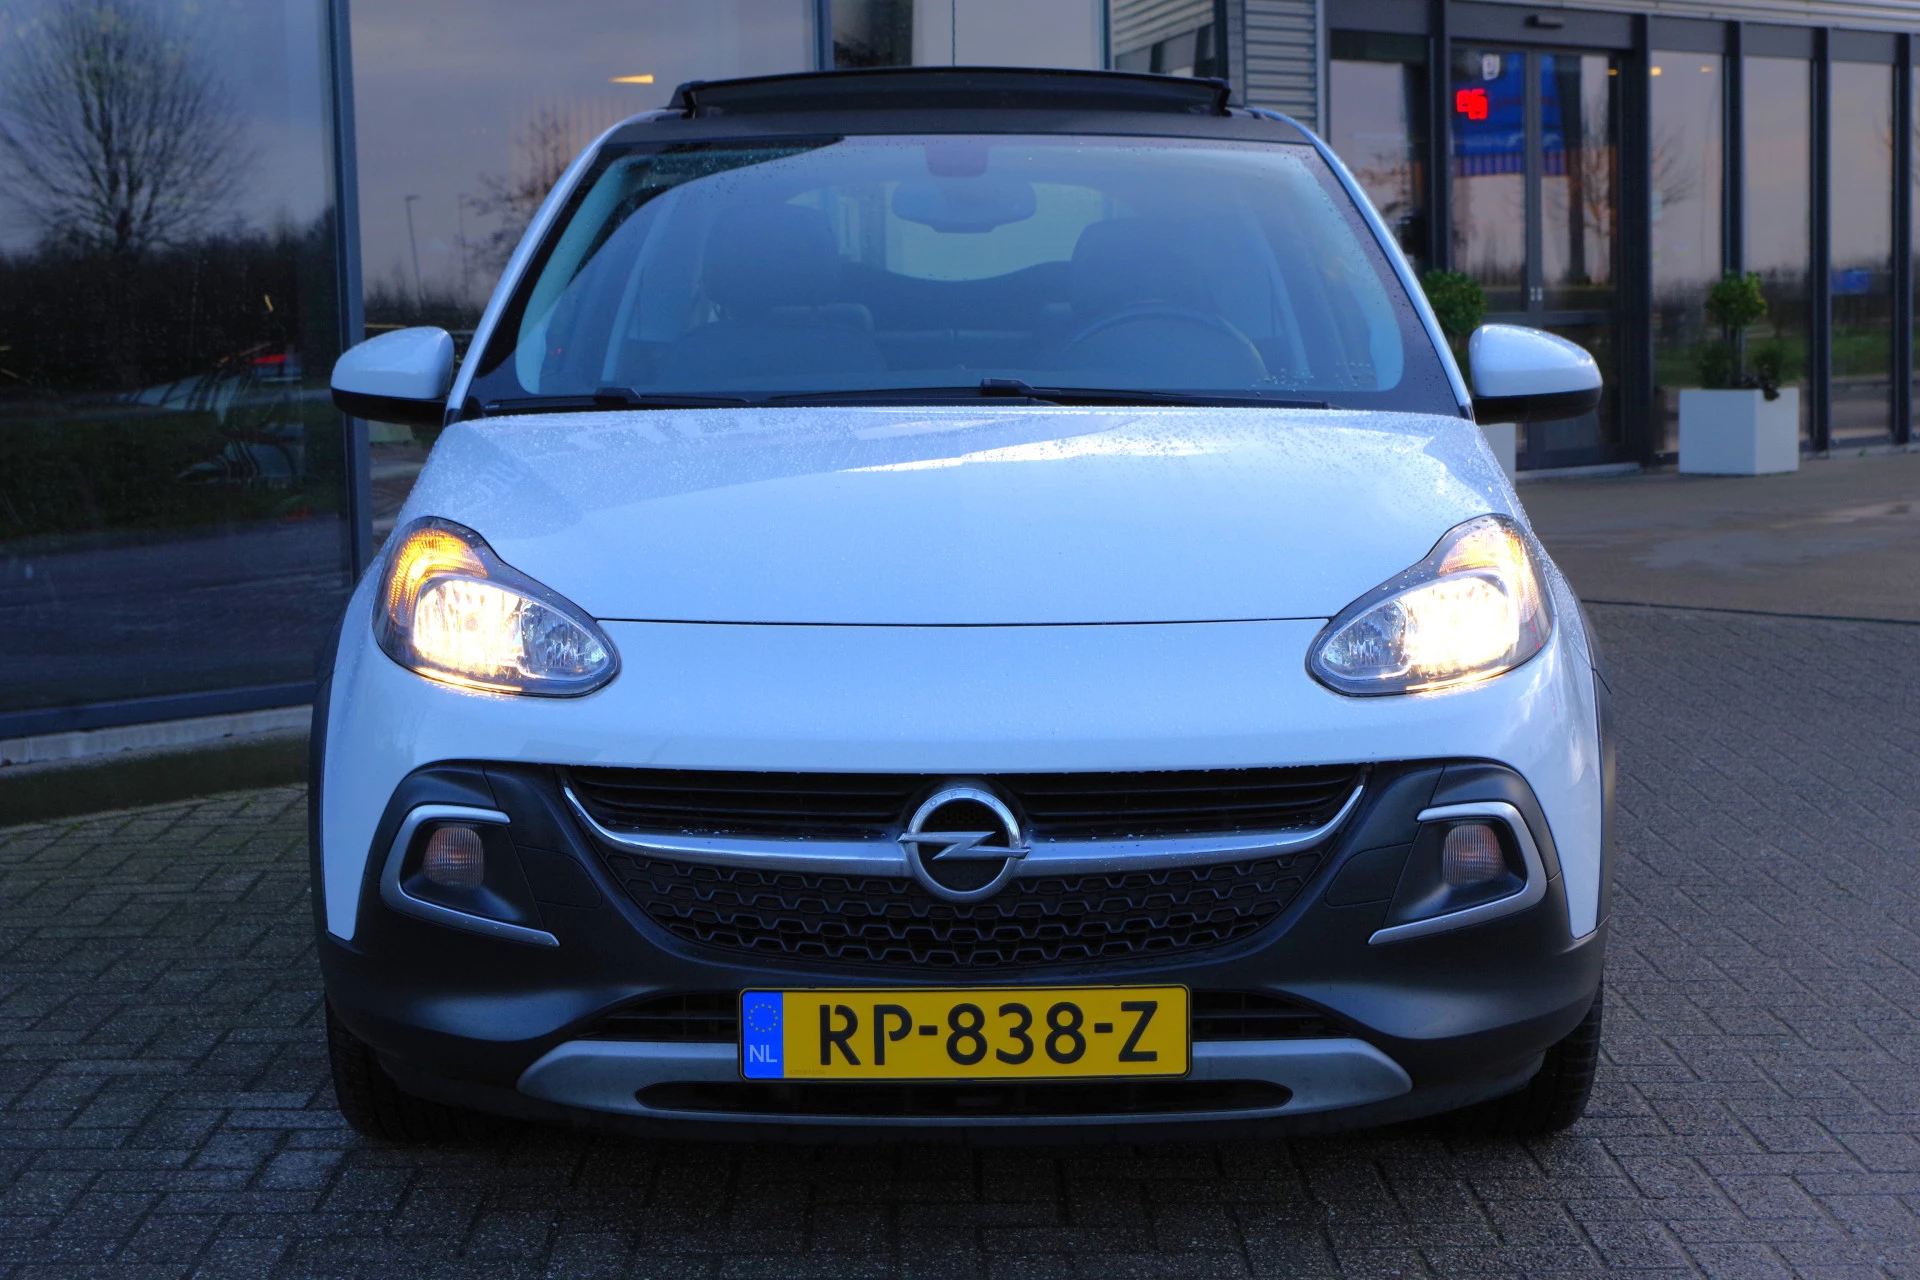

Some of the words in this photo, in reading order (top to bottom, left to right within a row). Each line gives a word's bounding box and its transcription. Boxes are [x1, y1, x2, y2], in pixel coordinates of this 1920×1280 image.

[929, 790, 997, 807] OPEL
[819, 1001, 1158, 1066] RP-838-Z
[749, 1044, 778, 1063] NL
